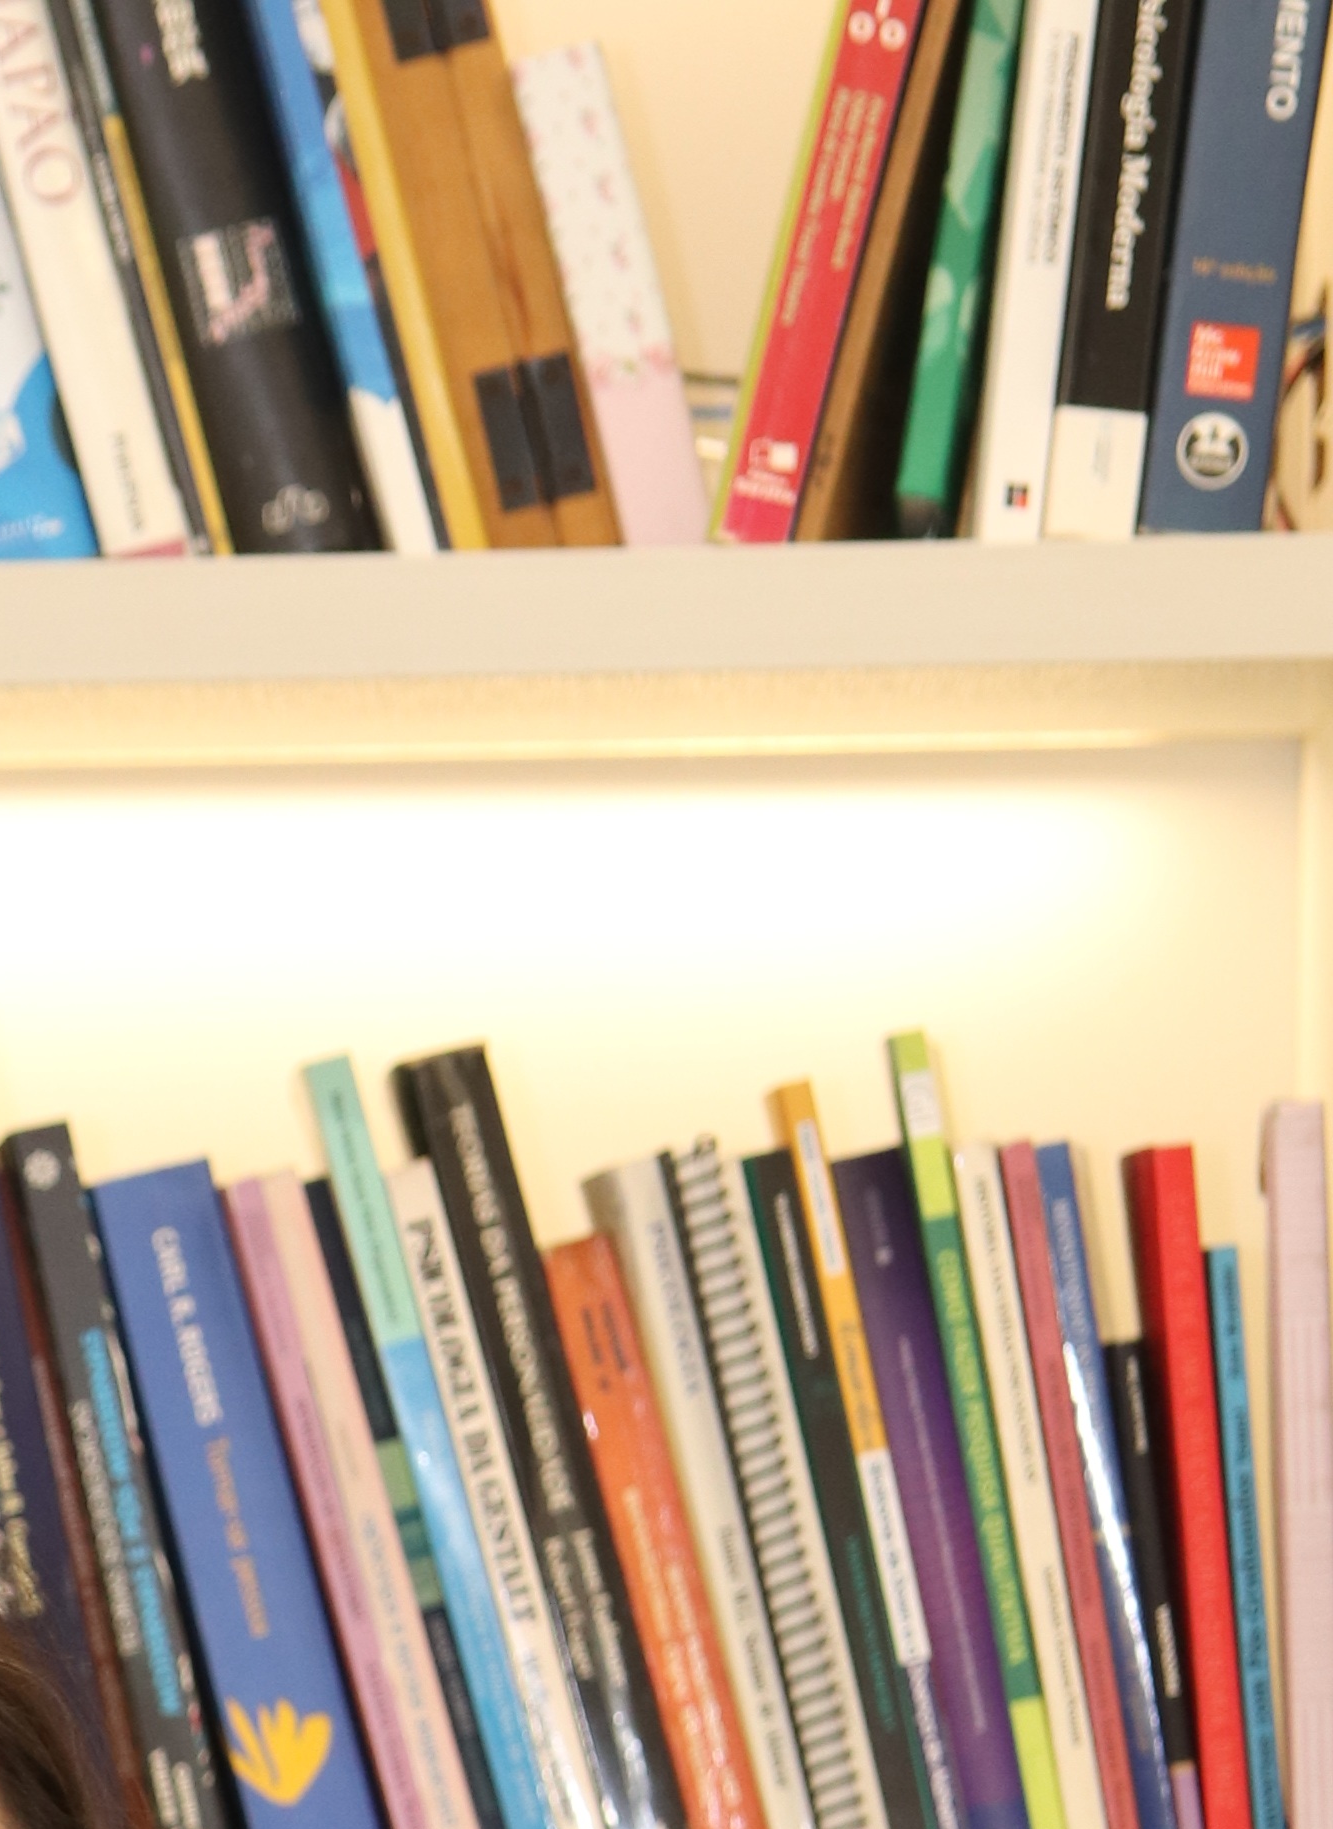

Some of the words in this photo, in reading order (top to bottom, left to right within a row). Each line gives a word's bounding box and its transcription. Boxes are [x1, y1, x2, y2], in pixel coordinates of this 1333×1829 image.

[1101, 152, 1154, 313] Moderna
[438, 1099, 499, 1230] TEORIAS
[472, 1224, 513, 1280] DA
[148, 1222, 195, 1296] CARL
[172, 1318, 229, 1429] ROGERS
[400, 1215, 485, 1423] PSICOLOGIA
[926, 1246, 970, 1325] COMO
[458, 1425, 500, 1477] DA
[472, 1475, 542, 1627] GESTALT
